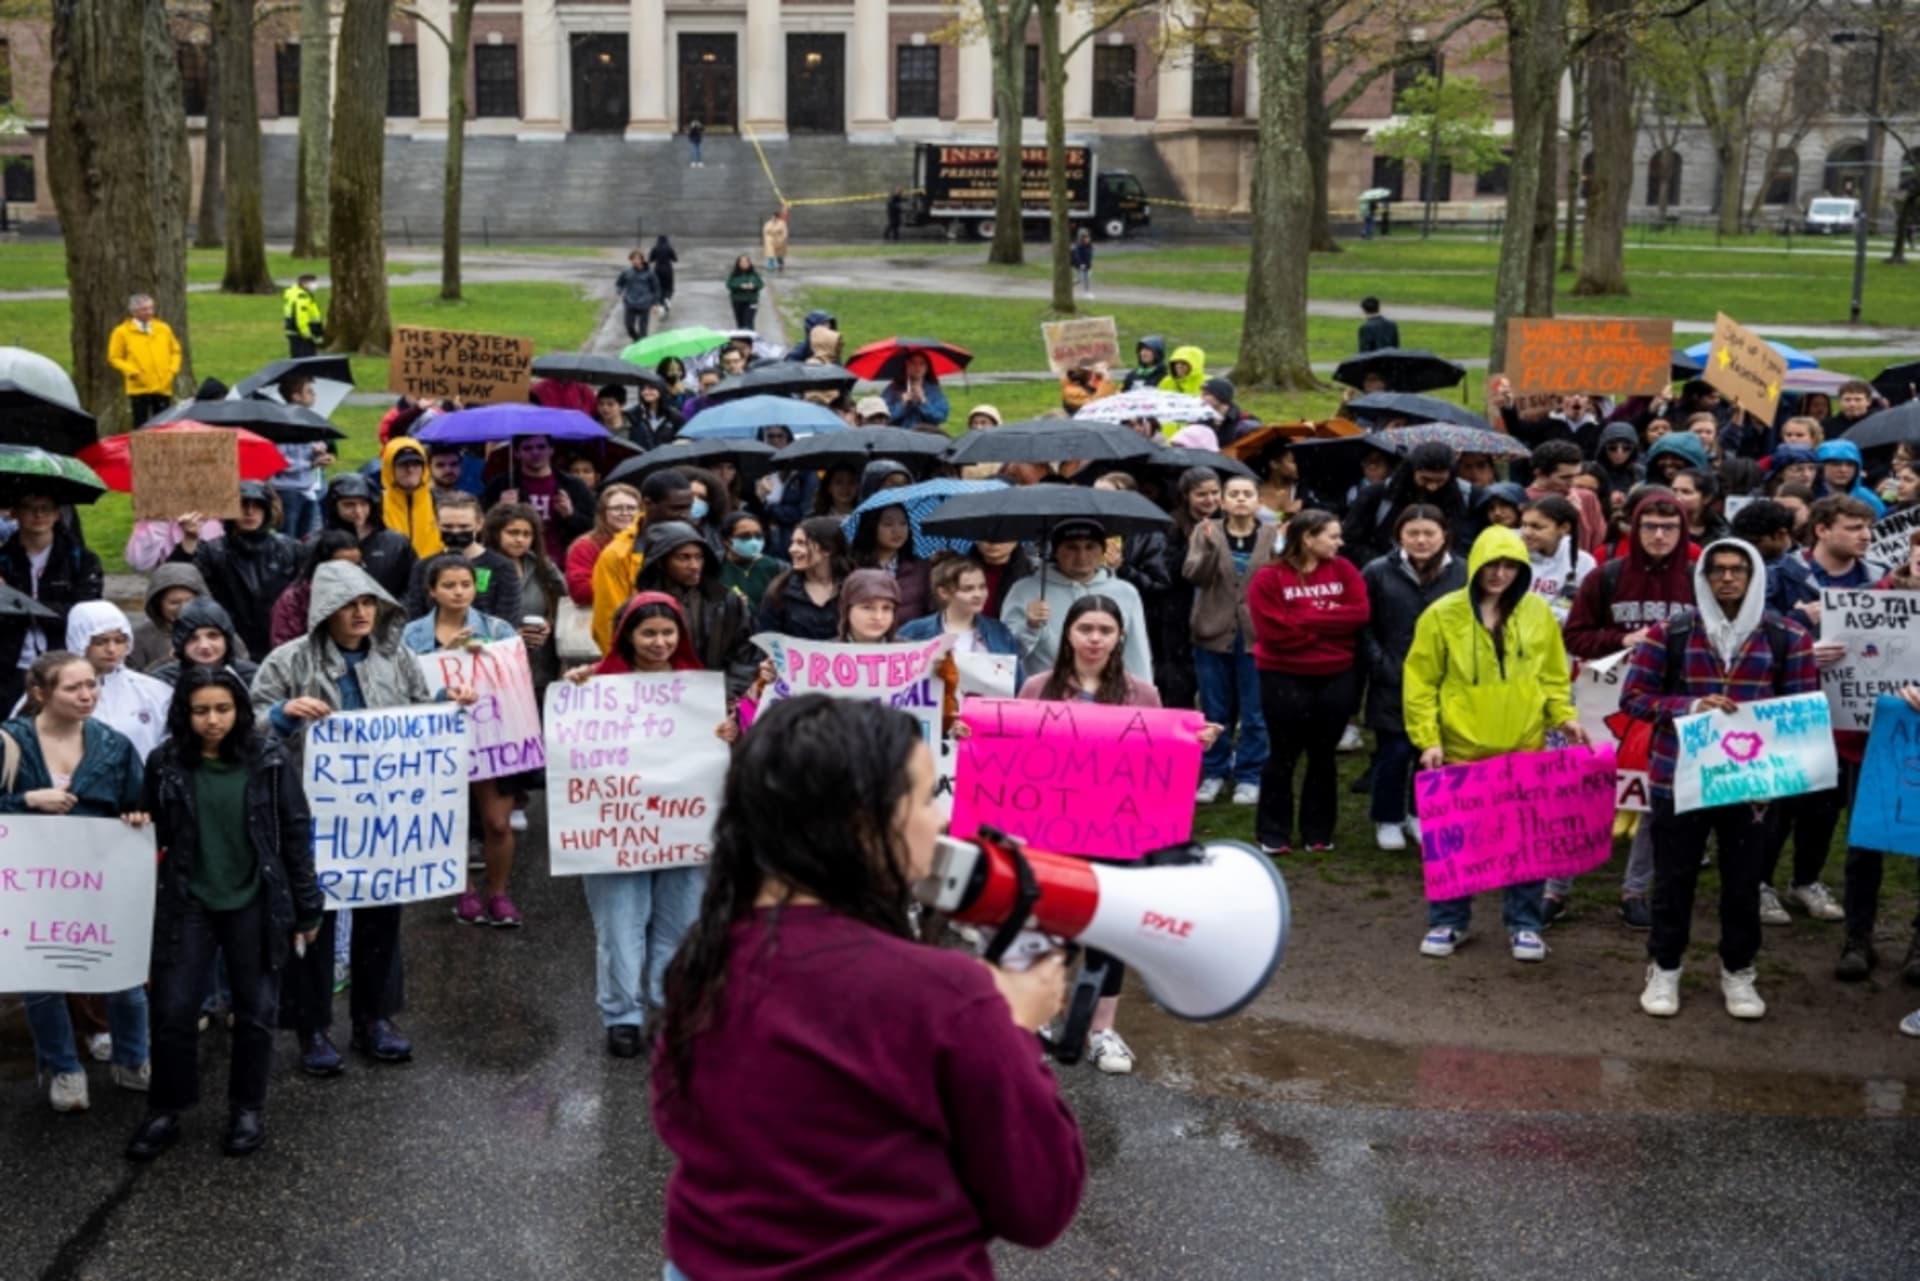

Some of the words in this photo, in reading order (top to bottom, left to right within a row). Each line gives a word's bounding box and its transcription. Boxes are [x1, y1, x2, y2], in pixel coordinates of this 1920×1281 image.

[399, 327, 432, 343] THE
[439, 332, 519, 351] SYSTEM
[1520, 320, 1585, 343] WHEN
[1589, 320, 1641, 342] WILL
[403, 360, 424, 374] IT
[432, 363, 465, 377] WAS
[470, 366, 523, 384] BUILT
[457, 349, 529, 369] BROKEN
[403, 377, 450, 396] THIS
[457, 382, 495, 398] WAY
[1519, 366, 1595, 391] FUCK
[1599, 366, 1661, 391] OFF
[1845, 612, 1909, 629] ABOUT
[786, 642, 941, 688] PROTECT
[1823, 667, 1856, 682] THE
[553, 681, 618, 715] girls
[626, 678, 688, 714] just
[312, 712, 466, 745] REPRODUCTIVE
[555, 715, 635, 743] want
[642, 713, 676, 738] to
[979, 700, 1080, 739] I'M
[1118, 710, 1154, 748] A
[313, 746, 458, 784] RIGHTS
[569, 746, 630, 770] have
[968, 742, 1173, 791] WOMAN
[354, 787, 425, 806] are
[567, 775, 643, 804] BASIC
[973, 783, 1080, 815] NOT
[1112, 794, 1141, 823] A
[310, 809, 456, 860] HUMAN
[559, 825, 660, 850] HUMAN
[616, 843, 710, 869] RIGHTS
[318, 857, 458, 901] RIGHTS
[29, 920, 116, 945] LEGAL
[1141, 910, 1194, 938] PYLE
